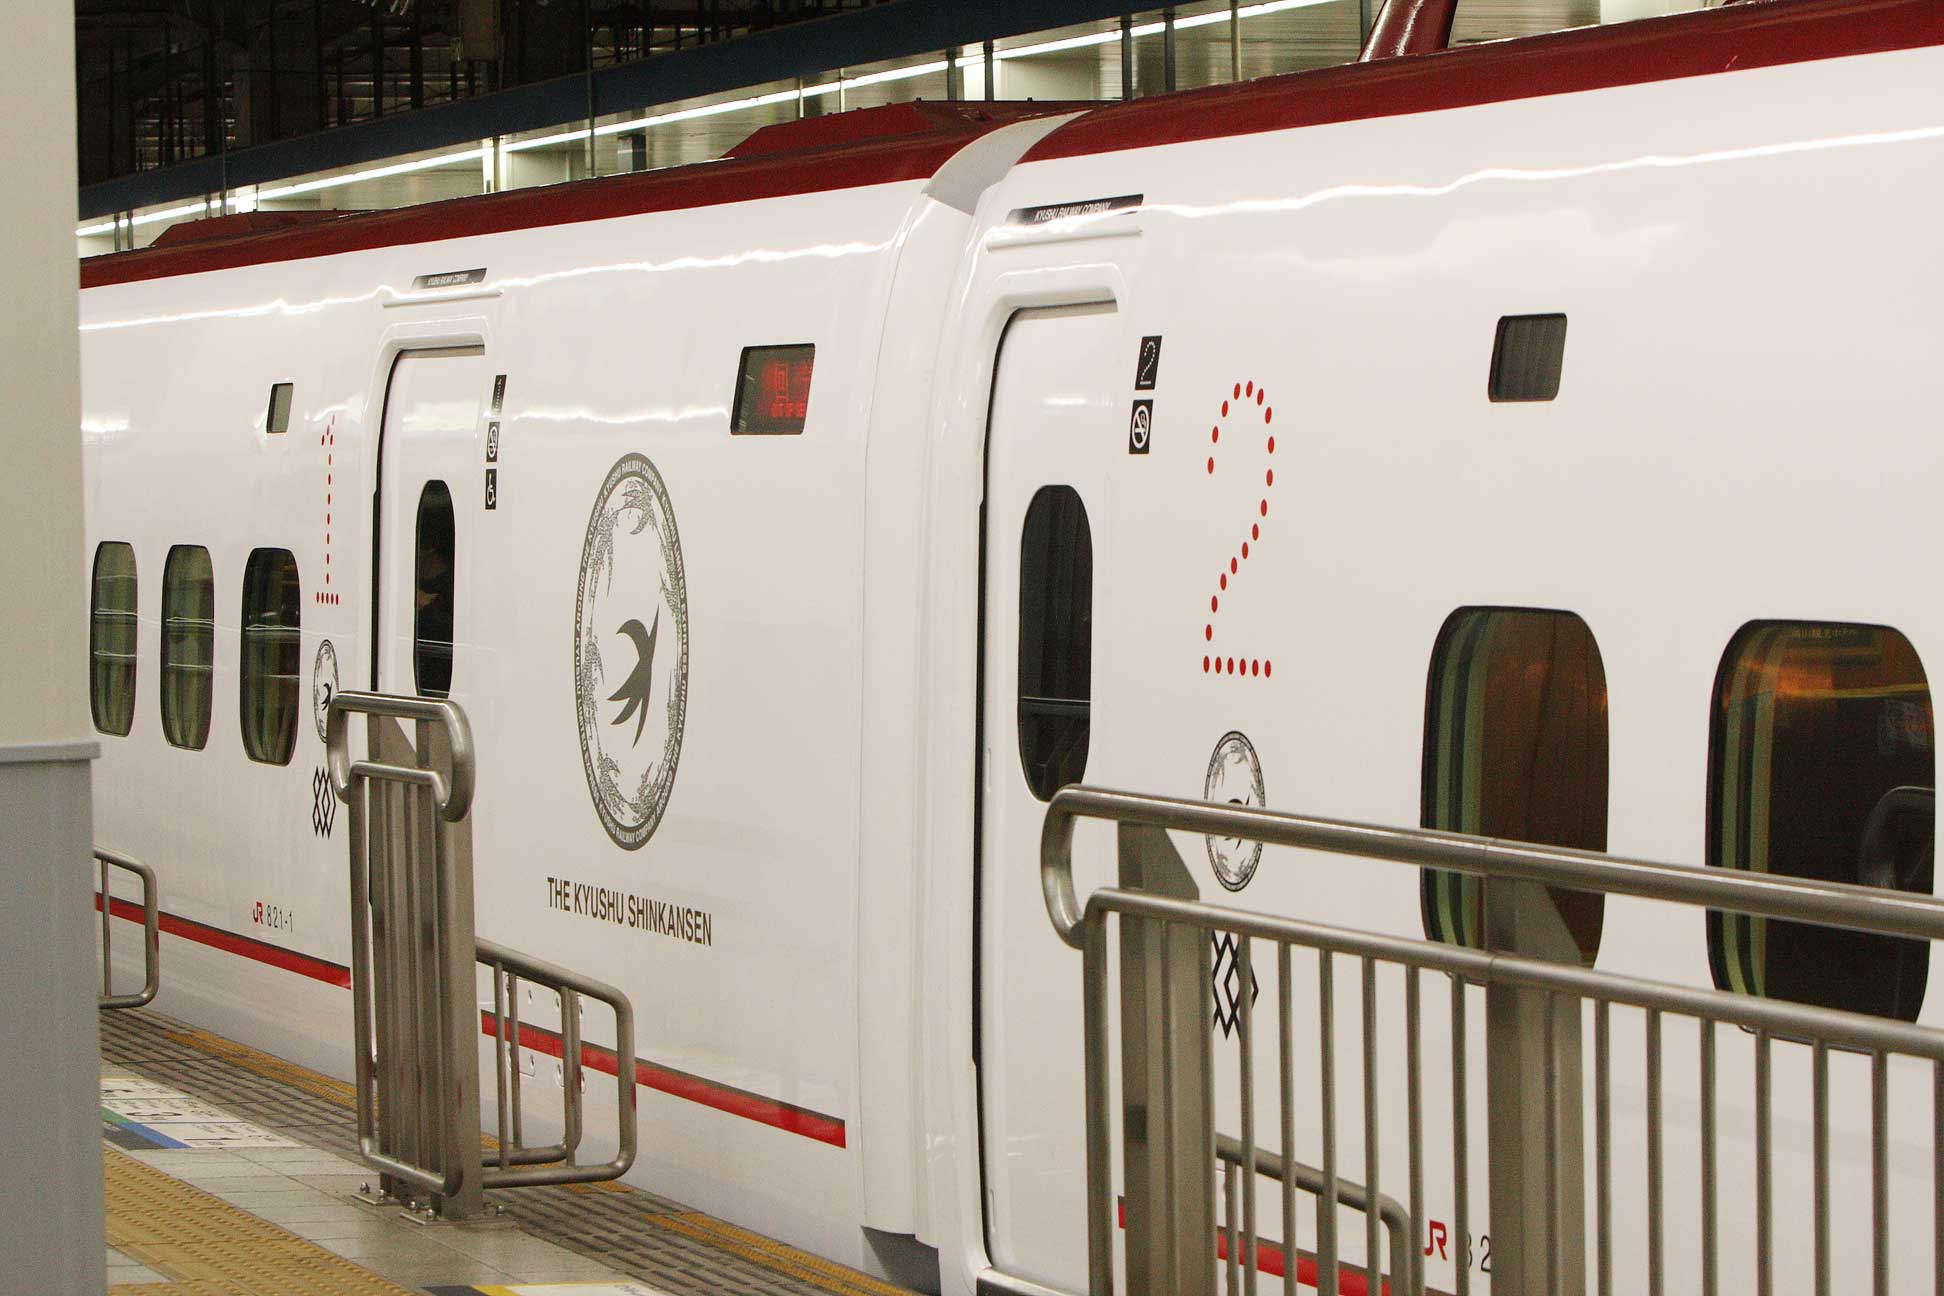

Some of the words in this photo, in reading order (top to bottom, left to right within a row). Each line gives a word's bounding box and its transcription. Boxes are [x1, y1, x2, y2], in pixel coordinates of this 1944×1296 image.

[1034, 207, 1060, 222] KYUSHU
[1082, 202, 1111, 215] COMPANY
[1139, 341, 1155, 385] 2
[315, 414, 340, 605] 1
[1203, 379, 1274, 678] 2
[582, 540, 590, 571] THE
[673, 540, 685, 599] LIMITED
[252, 901, 264, 925] JR
[266, 904, 293, 933] 821-1
[547, 876, 571, 912] THE
[574, 882, 624, 925] KYUSHU
[628, 894, 712, 947] SHINKANSEN
[1423, 1219, 1448, 1261] JR
